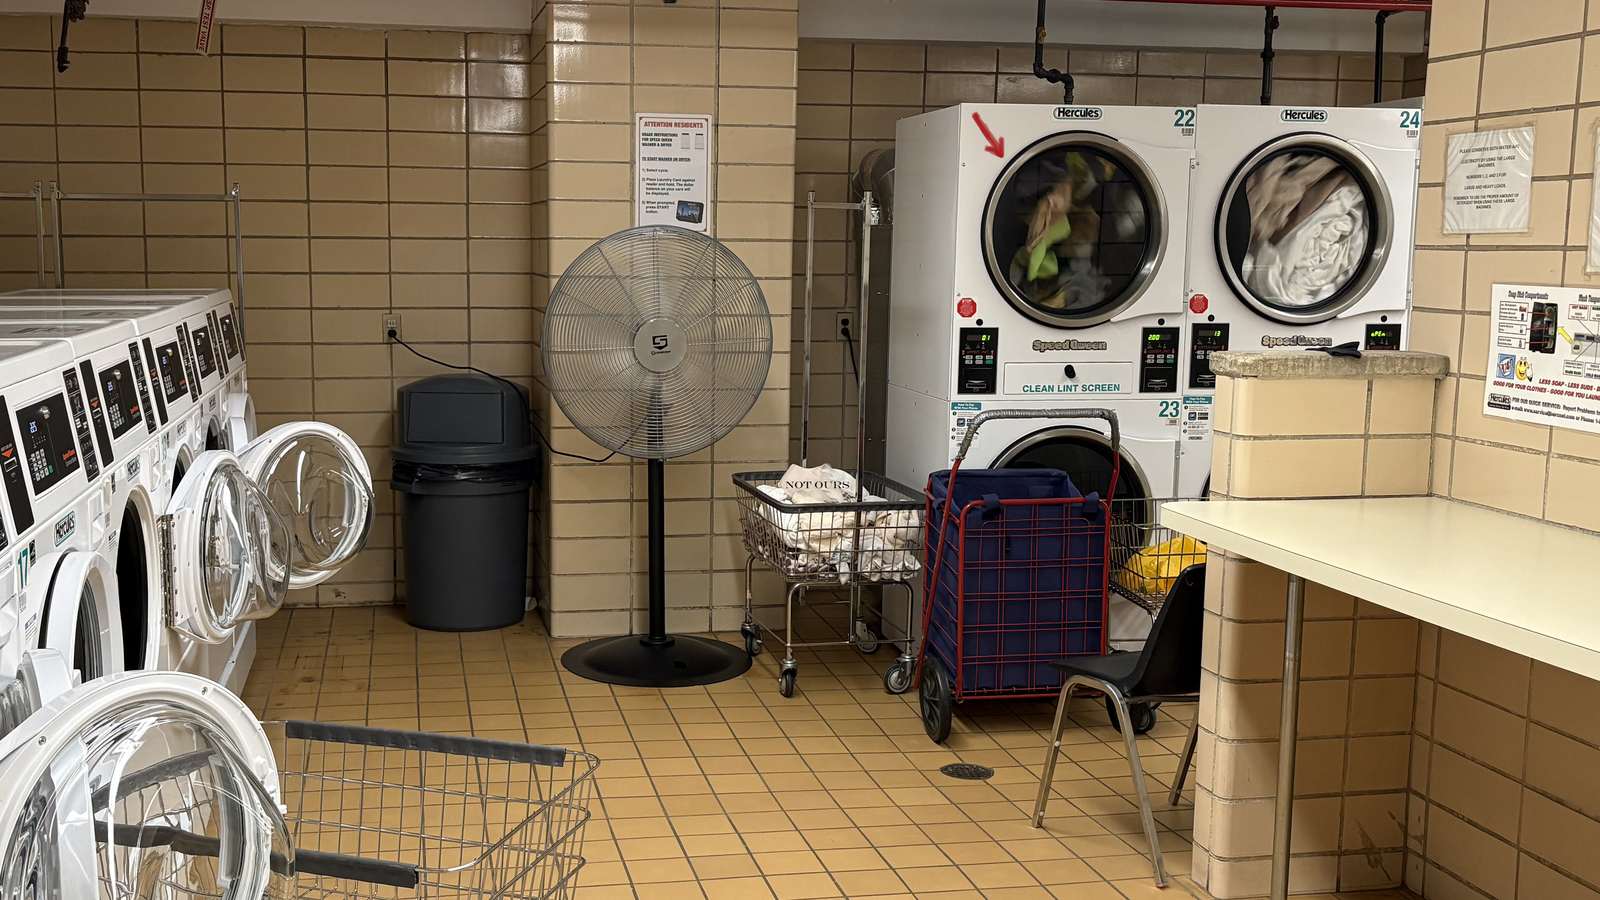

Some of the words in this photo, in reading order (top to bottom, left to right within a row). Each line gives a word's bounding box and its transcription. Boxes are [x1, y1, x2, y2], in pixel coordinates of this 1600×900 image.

[1057, 107, 1099, 118] Hercules
[1174, 109, 1195, 127] 22
[1284, 110, 1324, 120] Hercules
[1399, 111, 1420, 128] 24
[1032, 339, 1070, 352] Speed
[1070, 339, 1107, 351] Queen
[1262, 335, 1297, 348] Speed
[1022, 384, 1054, 392] CLEAN
[1057, 384, 1079, 392] LINT
[1081, 384, 1120, 392] SCREEN
[1527, 385, 1546, 393] CLOTHES
[1158, 401, 1180, 418] 23
[18, 548, 28, 589] 17
